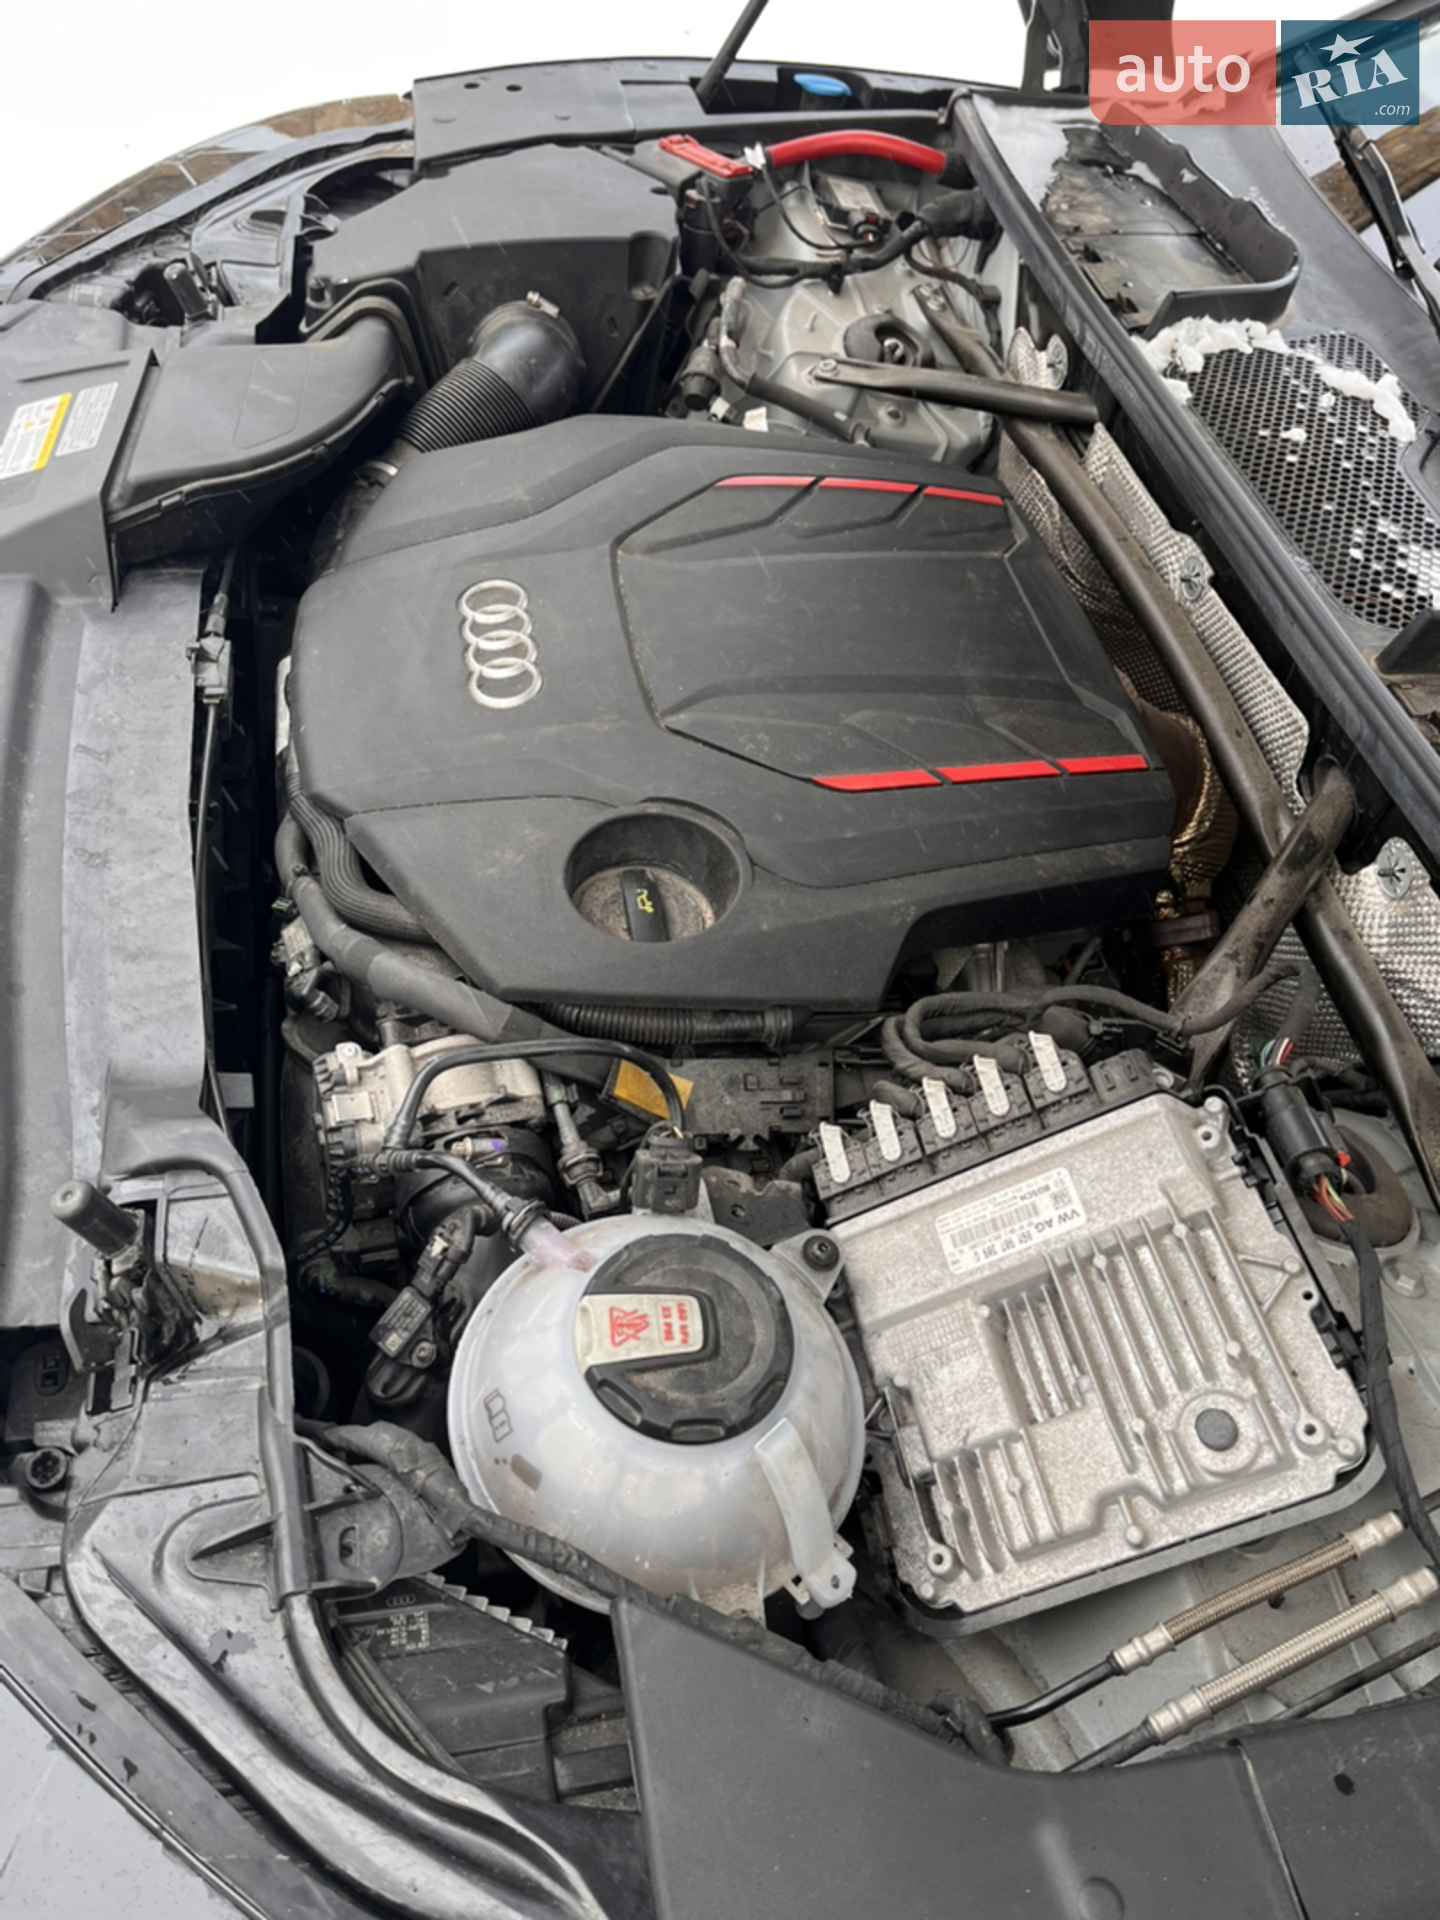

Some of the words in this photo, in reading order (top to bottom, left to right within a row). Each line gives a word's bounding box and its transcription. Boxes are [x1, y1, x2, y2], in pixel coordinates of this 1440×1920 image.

[1020, 1183, 1051, 1201] BOSCH
[1034, 1217, 1054, 1233] AG
[1057, 1208, 1081, 1225] VW
